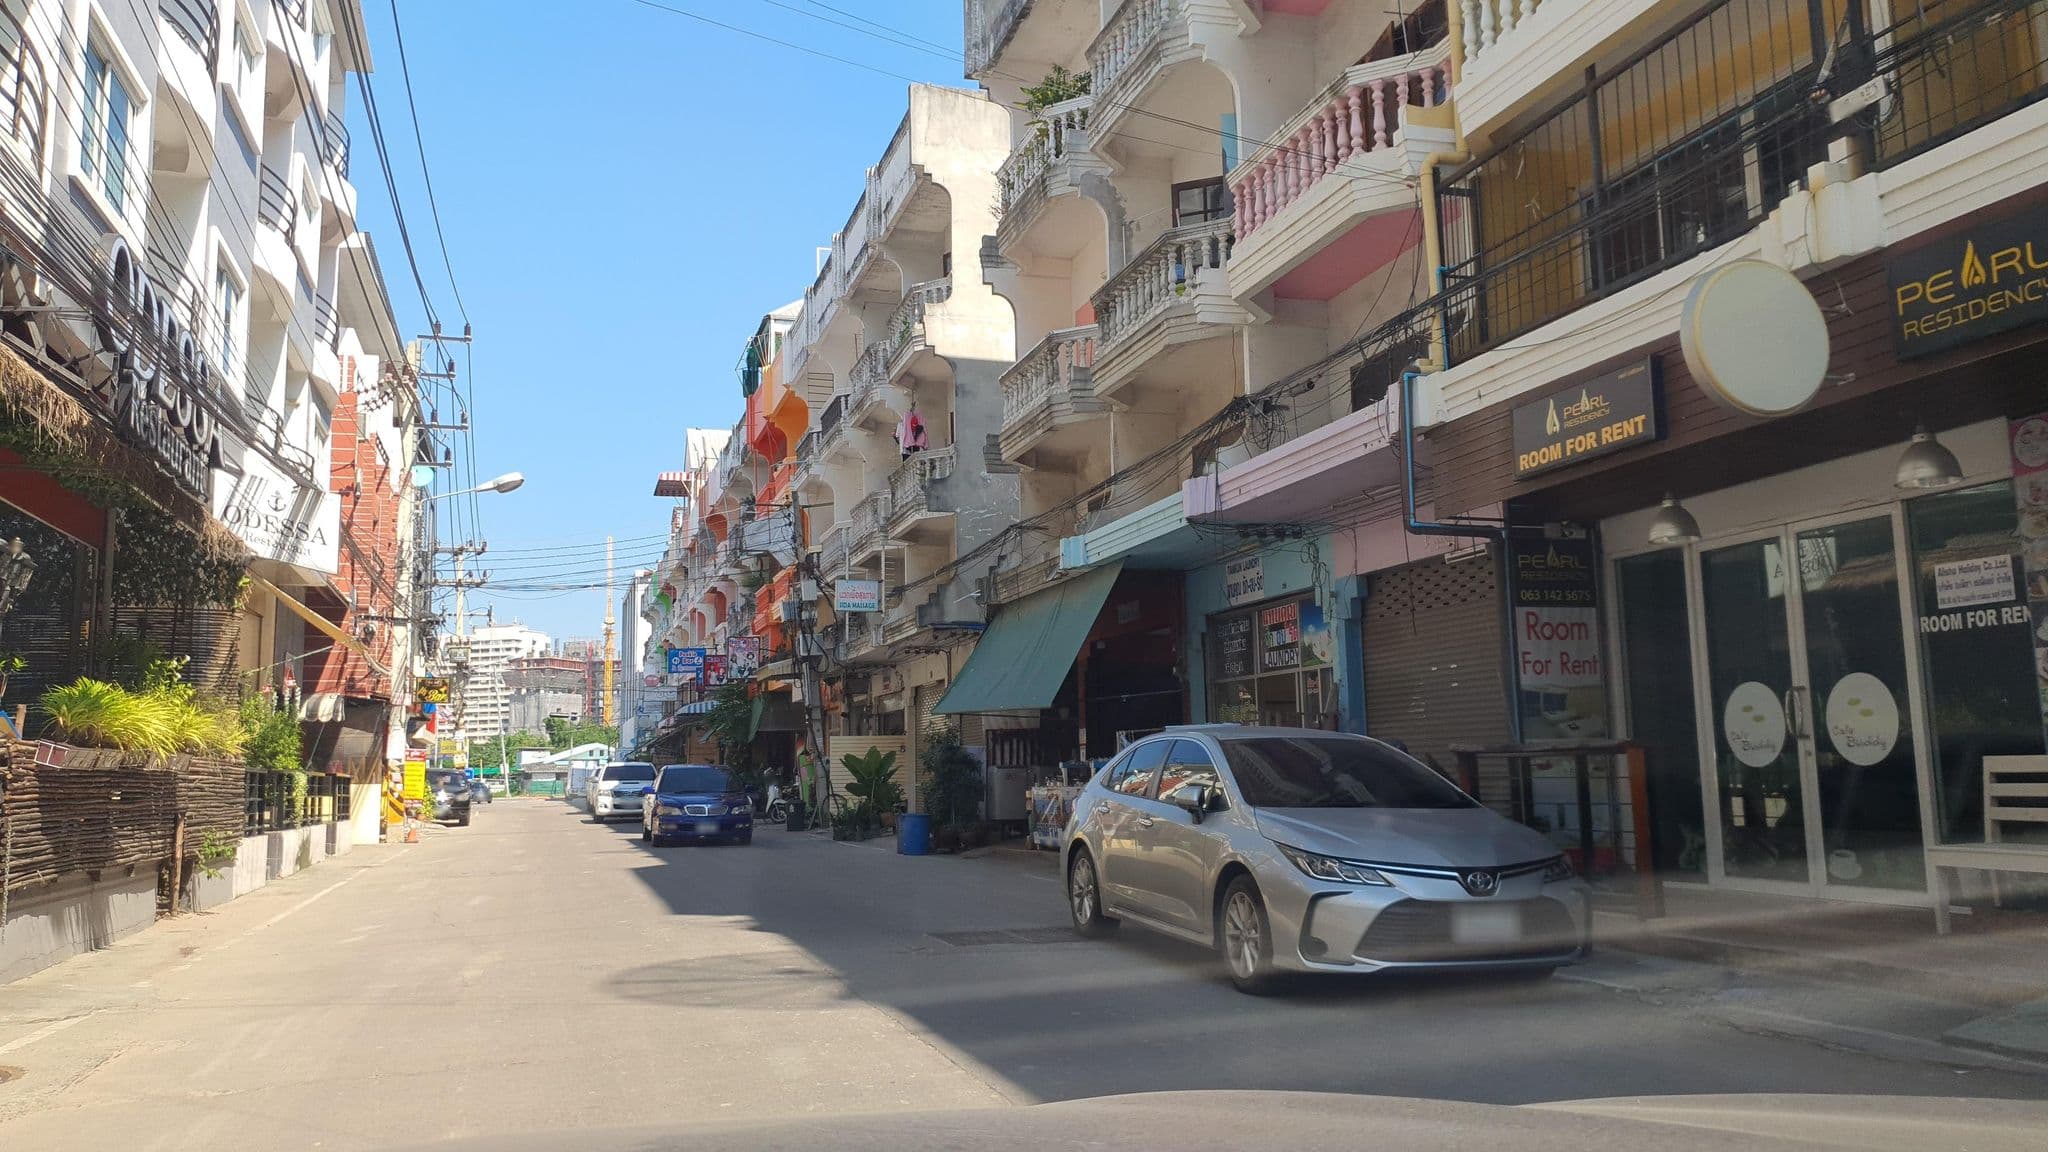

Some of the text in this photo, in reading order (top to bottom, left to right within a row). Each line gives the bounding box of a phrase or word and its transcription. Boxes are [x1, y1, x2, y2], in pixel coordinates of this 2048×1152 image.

[1563, 407, 1610, 428] RESIDENCY
[1519, 414, 1647, 471] ROOM FOR RENT
[224, 505, 327, 546] ODESSA
[1525, 611, 1589, 641] Room
[1920, 605, 2033, 633] ROOM FOR REN
[1521, 652, 1599, 676] For Rent
